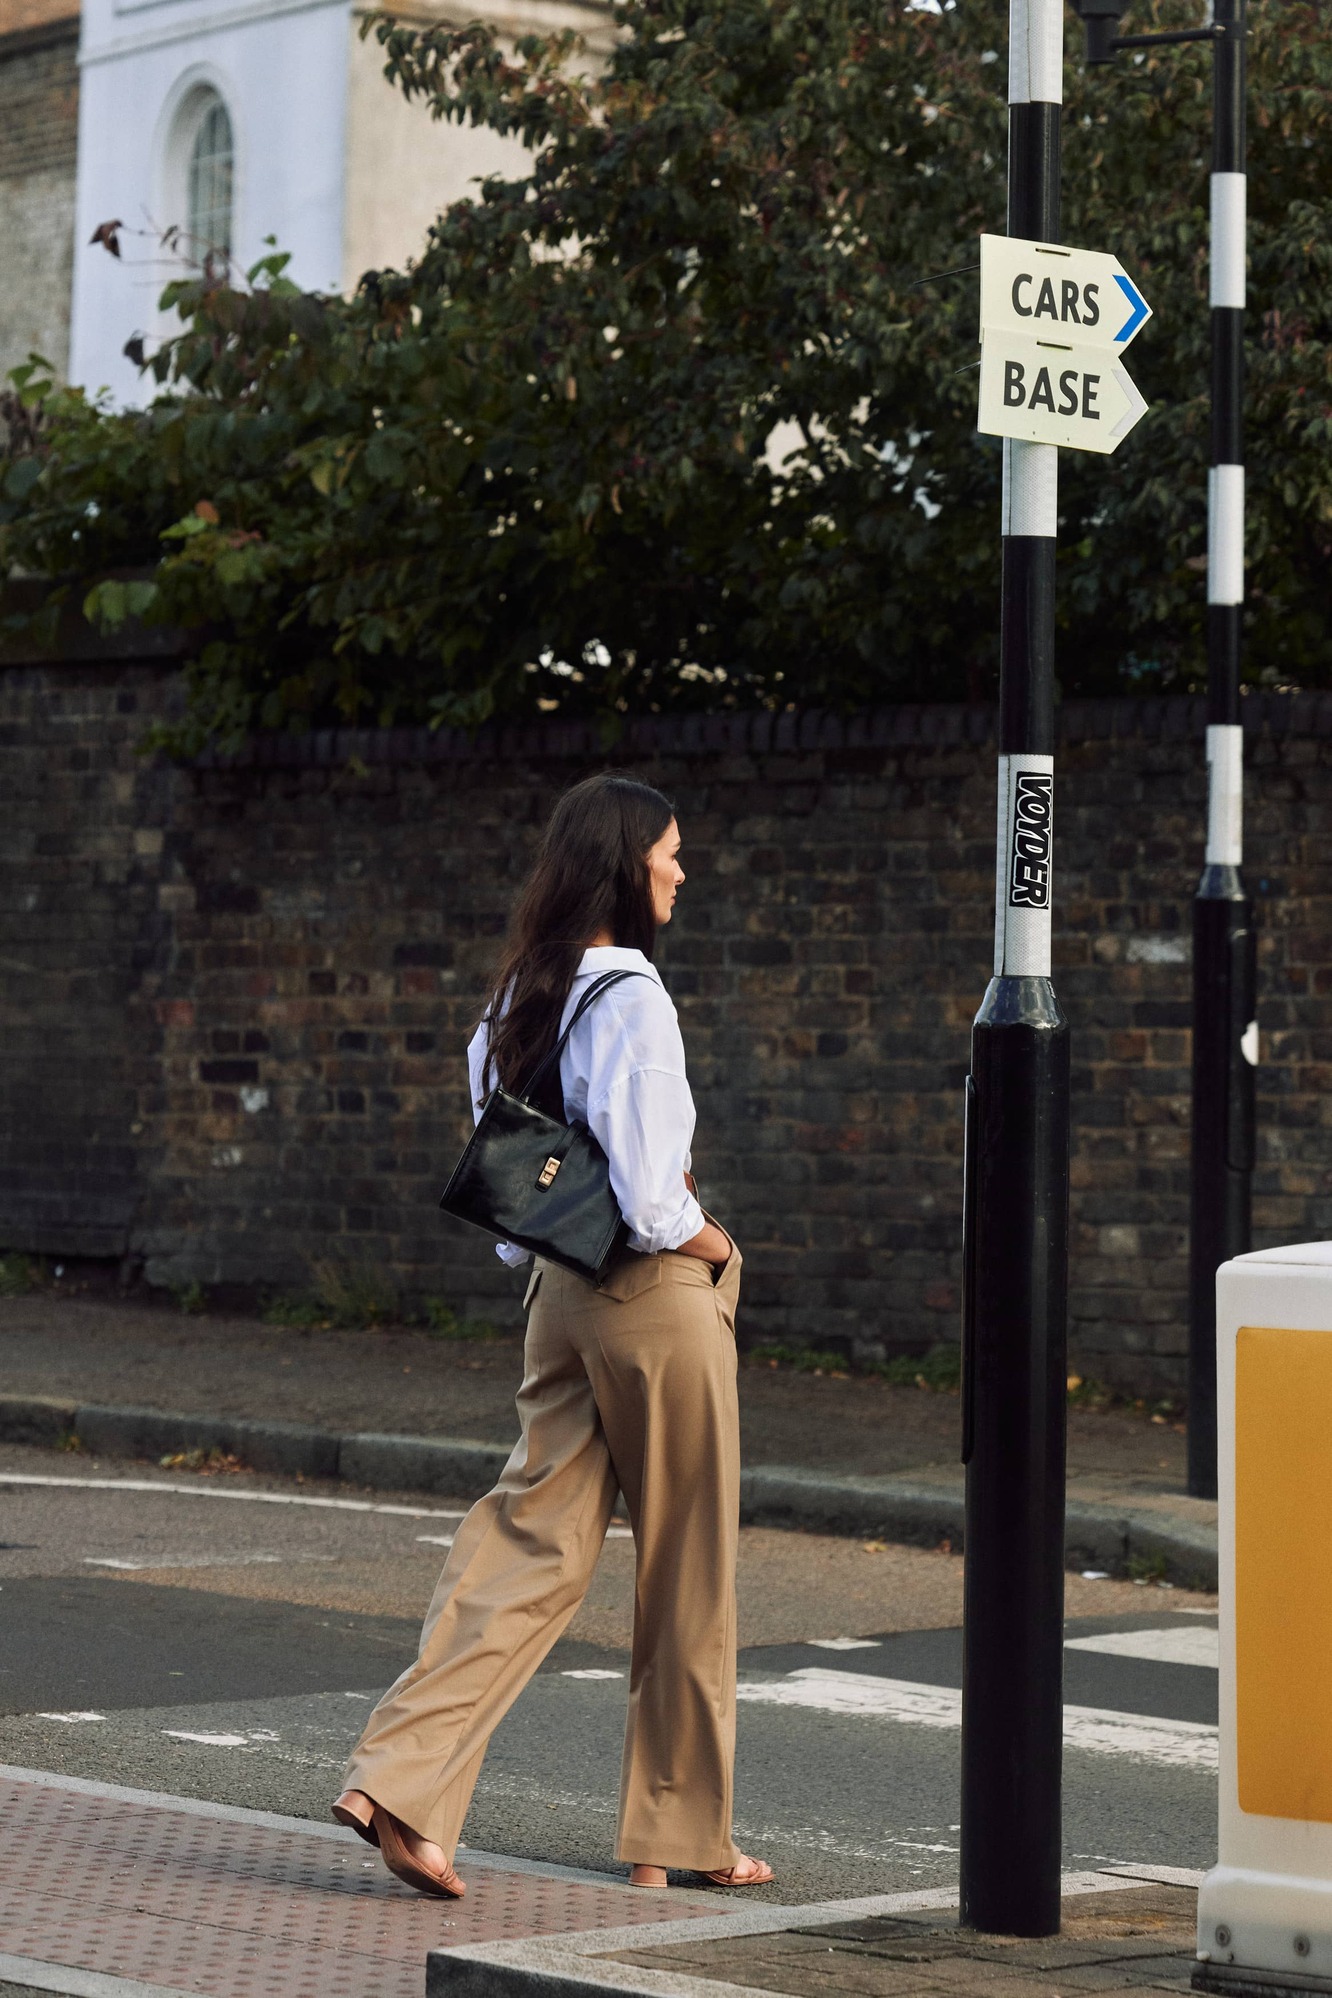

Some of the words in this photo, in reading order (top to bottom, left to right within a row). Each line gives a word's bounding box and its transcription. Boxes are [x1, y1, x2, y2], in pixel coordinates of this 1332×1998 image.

[1011, 273, 1100, 326] CARS
[1003, 360, 1100, 420] BASE
[1012, 776, 1052, 908] VOYDER
